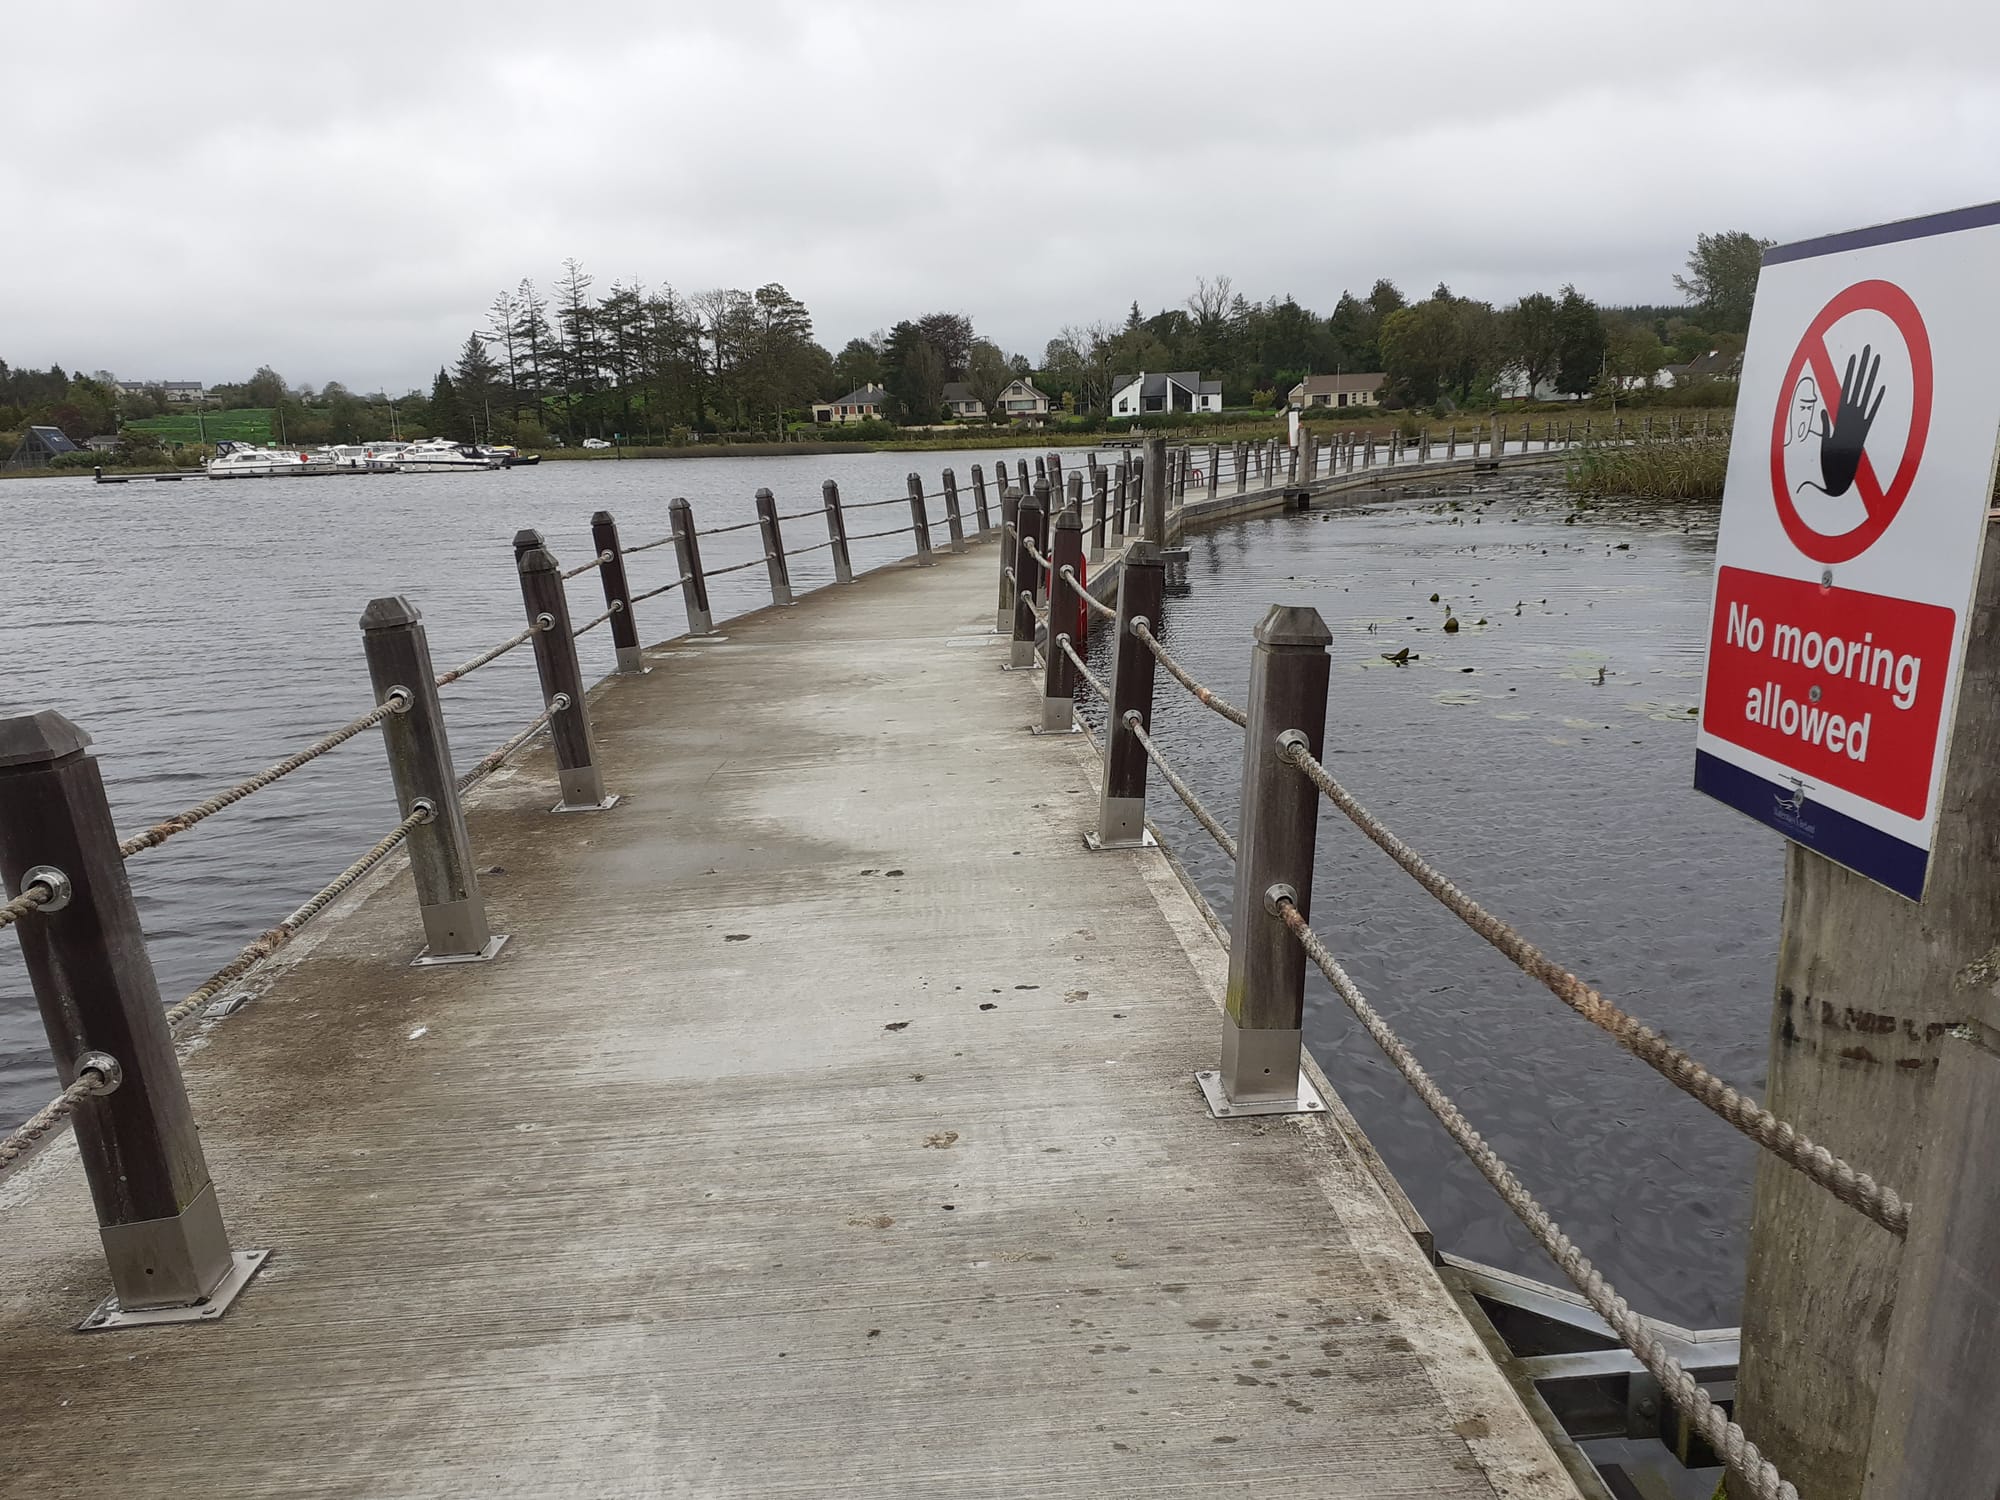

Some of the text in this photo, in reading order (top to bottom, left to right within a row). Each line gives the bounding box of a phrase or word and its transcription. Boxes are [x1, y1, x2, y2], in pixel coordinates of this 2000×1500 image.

[1726, 601, 1921, 710] No mooring
[1745, 681, 1872, 763] allowed
